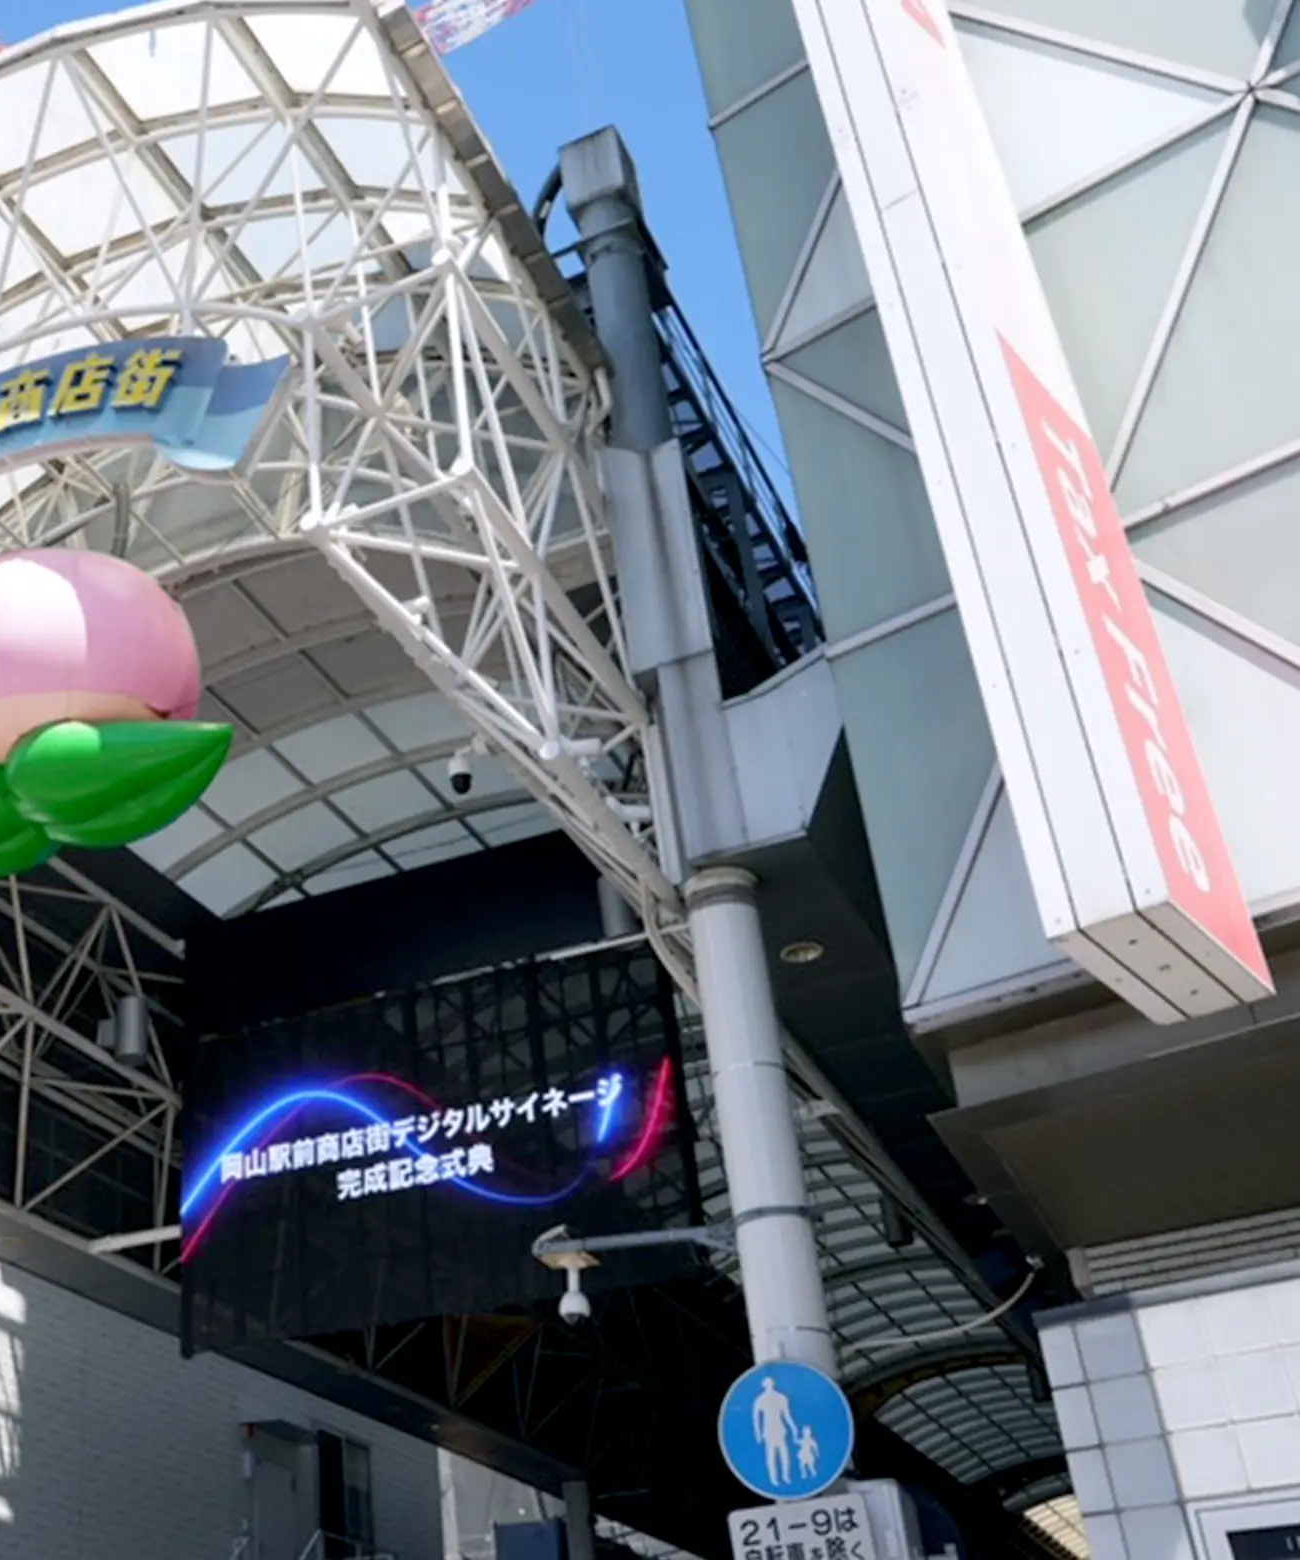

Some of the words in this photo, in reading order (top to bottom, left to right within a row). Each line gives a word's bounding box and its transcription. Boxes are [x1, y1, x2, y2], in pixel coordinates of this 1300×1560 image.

[1041, 417, 1122, 613] Tax
[1103, 613, 1211, 894] Free
[219, 1073, 623, 1184] 岡山駅前商店街デジタルサイネージ
[336, 1142, 495, 1201] 完成記念式典
